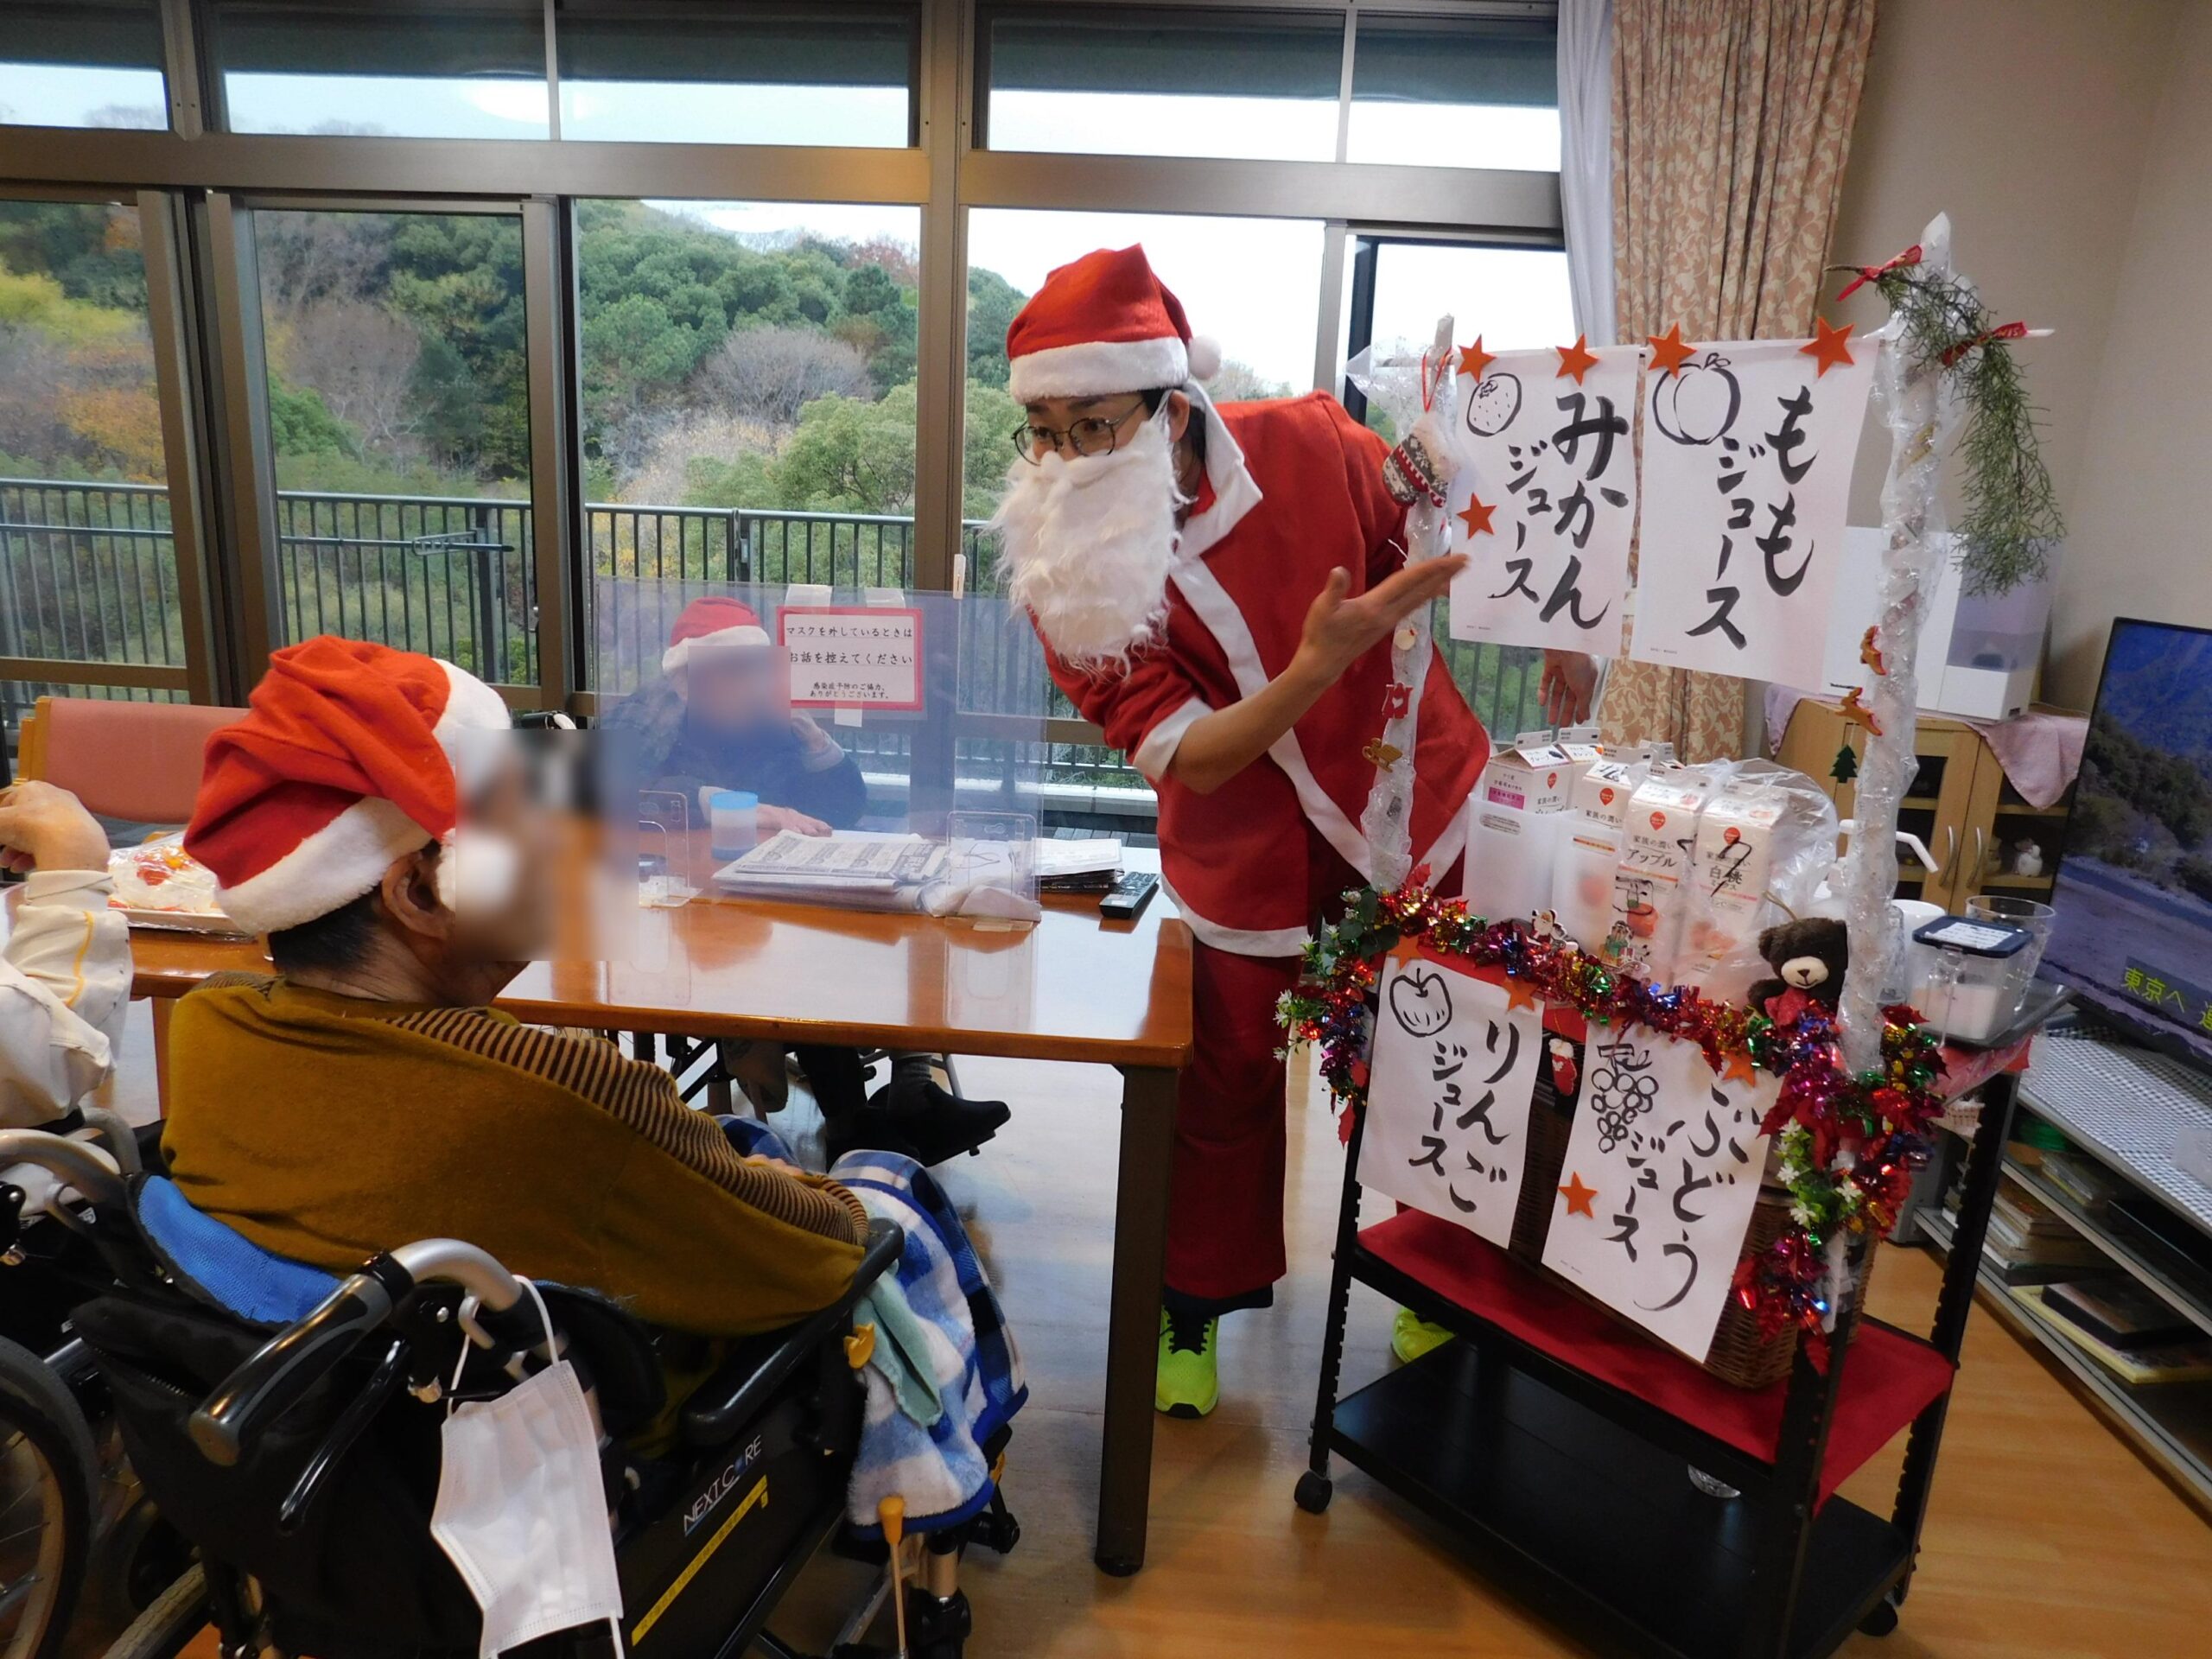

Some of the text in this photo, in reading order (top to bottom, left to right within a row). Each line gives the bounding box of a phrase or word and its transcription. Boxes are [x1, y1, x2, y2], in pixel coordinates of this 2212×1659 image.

[1487, 439, 1553, 603] ジュース
[1538, 391, 1630, 629] みかん
[1685, 435, 1766, 651] ジュース
[1754, 385, 1819, 597] もも
[786, 626, 912, 638] マスクを外しているときは
[790, 652, 912, 664] お話を控えてください
[1626, 848, 1678, 868] アップル
[2120, 967, 2184, 1014] 東京へ
[1408, 1040, 1468, 1177] ジュース
[1450, 1019, 1520, 1213] りんご
[1602, 1130, 1665, 1263] ジュース
[1633, 1084, 1764, 1312] ぶどう
